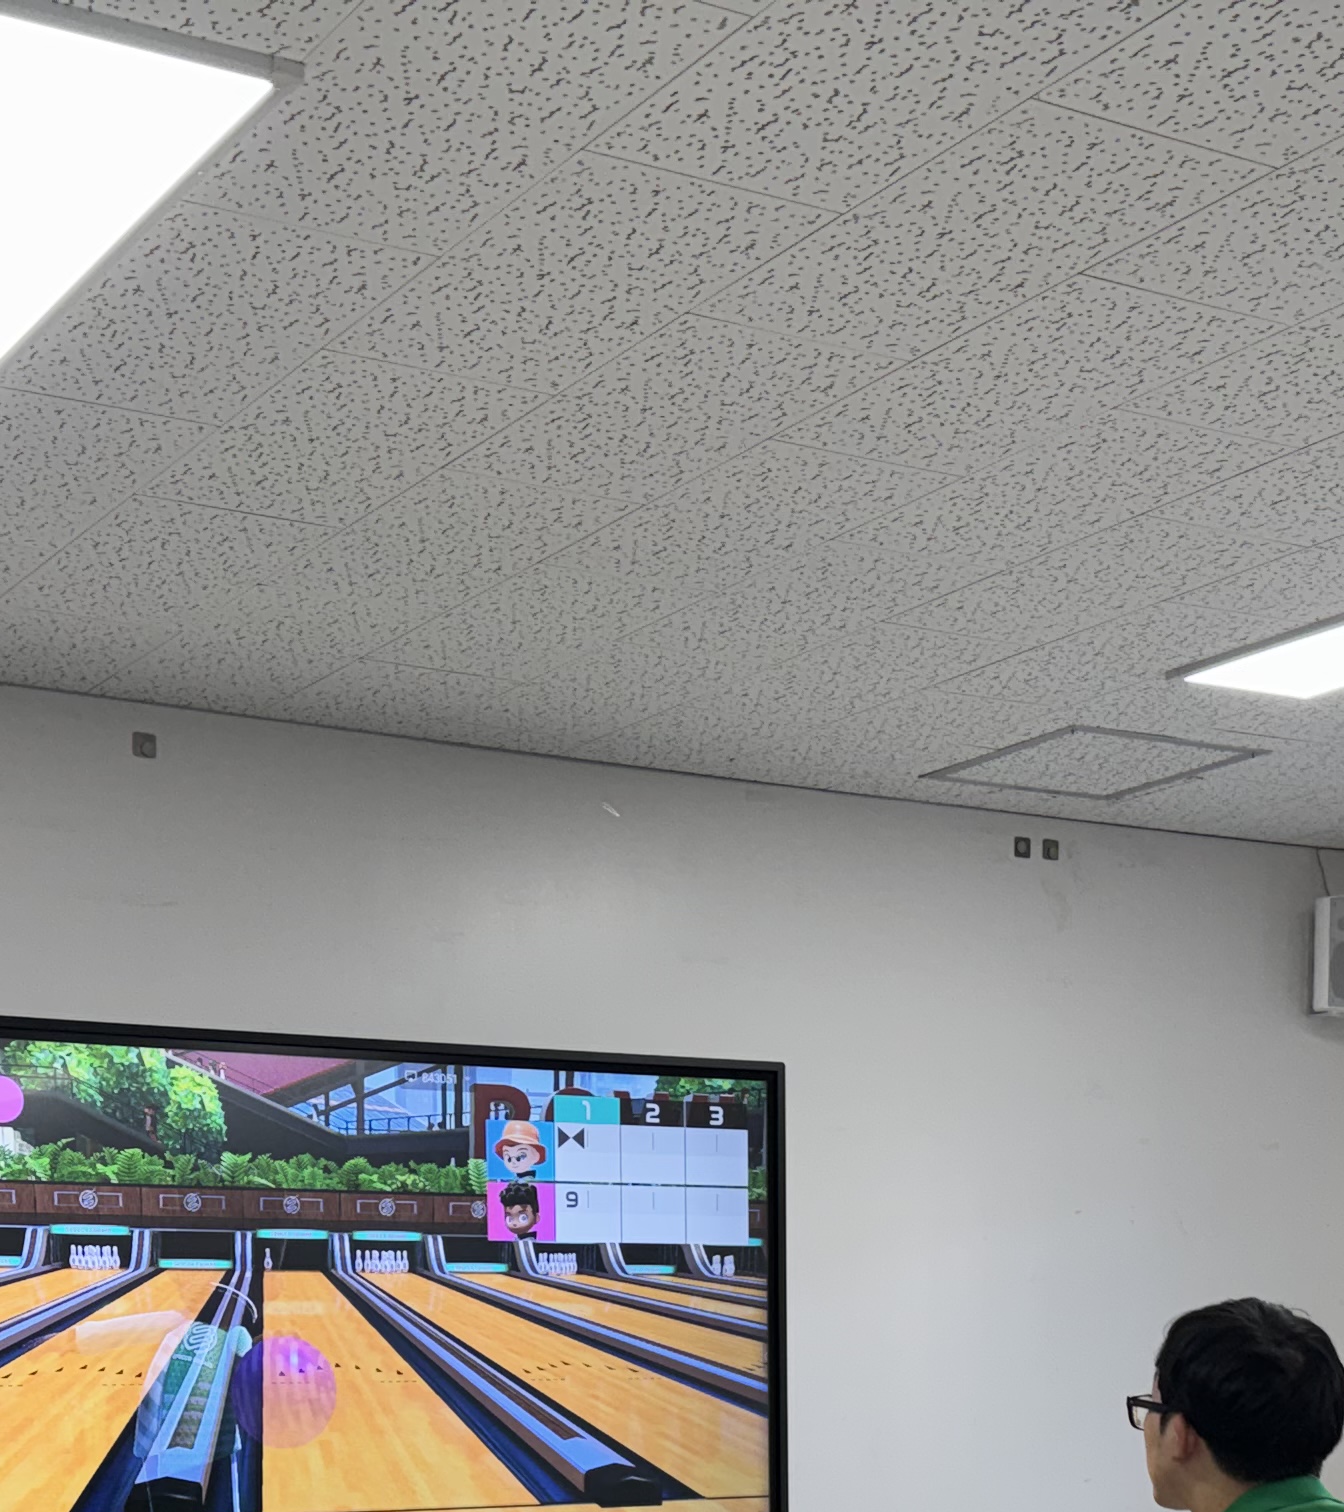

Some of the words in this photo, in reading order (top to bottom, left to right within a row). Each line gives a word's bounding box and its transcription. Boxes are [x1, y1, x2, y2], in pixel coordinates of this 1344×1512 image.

[581, 1100, 592, 1121] 1
[644, 1102, 661, 1124] 2
[708, 1105, 725, 1126] 3
[565, 1191, 579, 1209] 9
